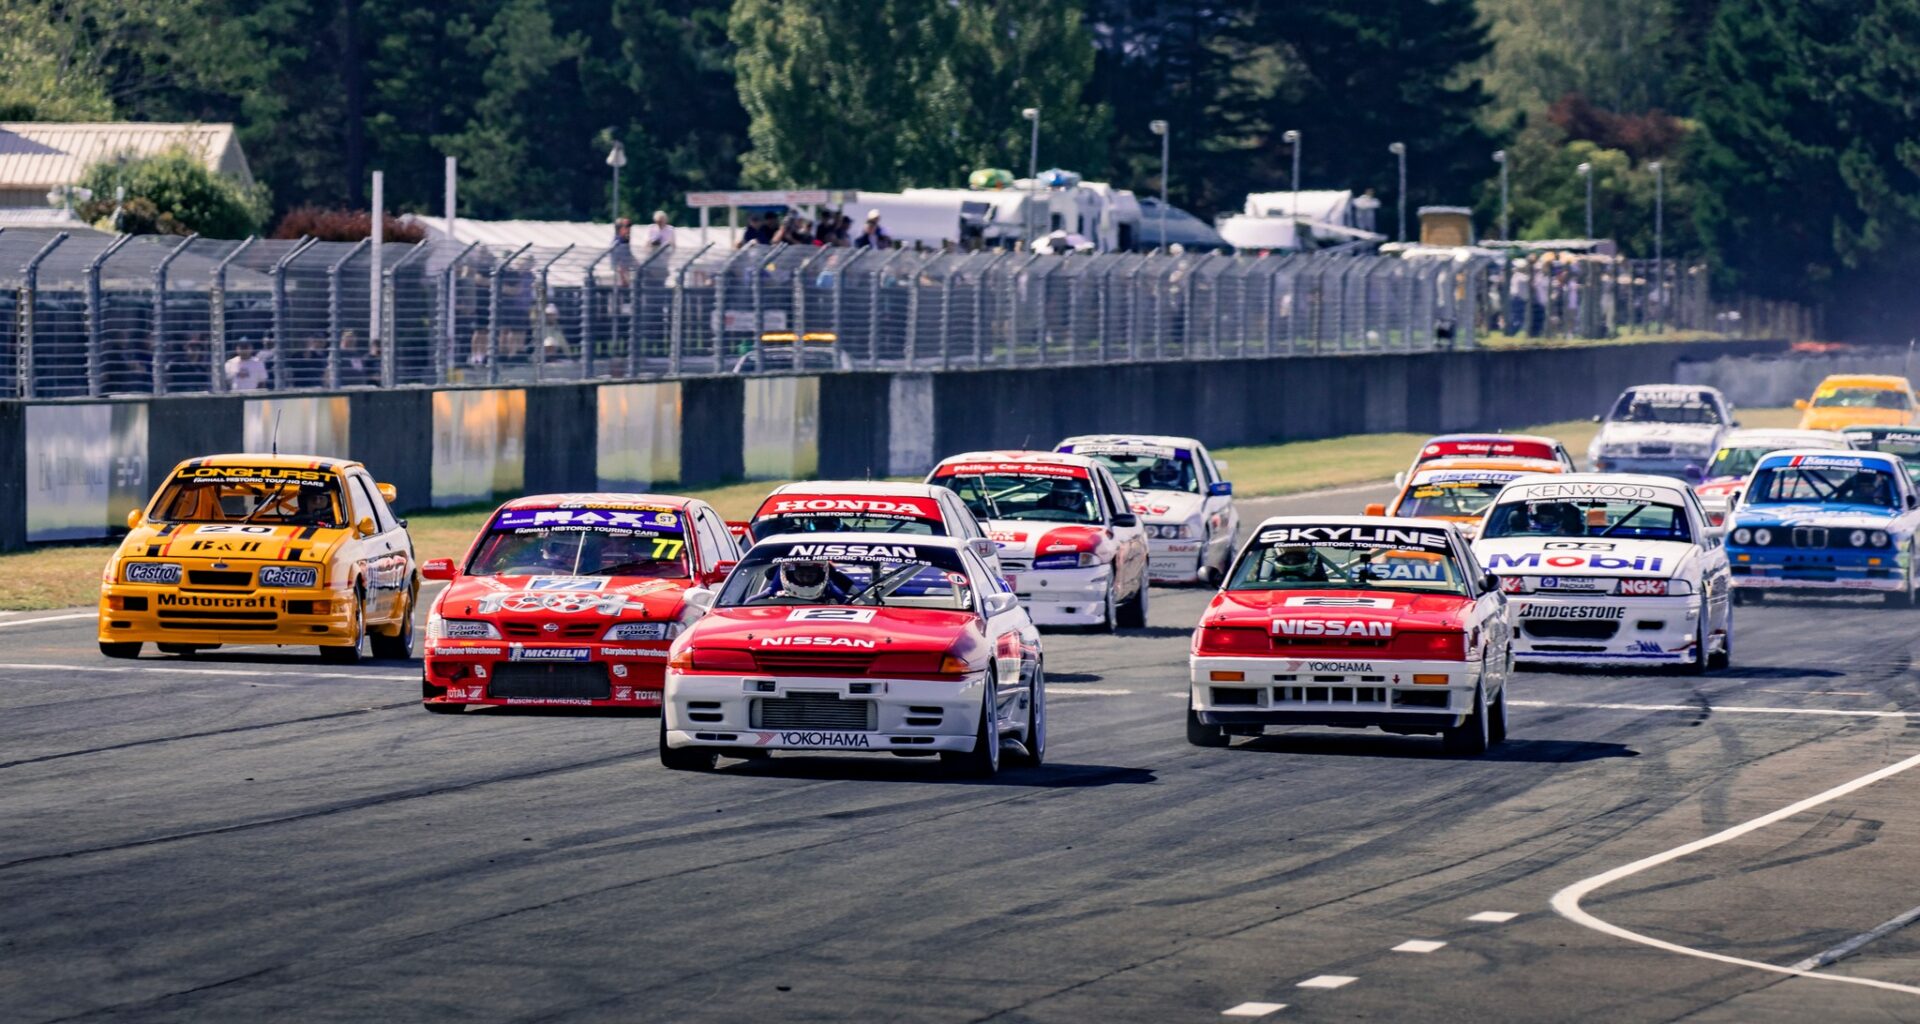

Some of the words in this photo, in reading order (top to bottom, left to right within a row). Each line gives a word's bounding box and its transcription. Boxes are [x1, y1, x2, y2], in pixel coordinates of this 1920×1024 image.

[177, 468, 338, 482] LONGHURST
[301, 480, 324, 488] CARS
[1526, 484, 1656, 498] KENWOOD
[774, 499, 926, 516] HONDA
[200, 525, 272, 534] 20
[551, 525, 592, 533] HISTORIC
[594, 526, 633, 534] TOURING
[633, 529, 660, 537] CARS
[1259, 527, 1446, 549] SKYLINE
[652, 538, 684, 560] 77
[788, 545, 917, 558] NISSAN
[1356, 542, 1397, 550] TOURING
[860, 556, 903, 564] TOURING
[1488, 553, 1663, 571] Mobil
[130, 565, 178, 580] Castrol
[263, 569, 313, 584] Castrol
[1621, 580, 1660, 594] NGK
[157, 593, 277, 608] Motorcraft
[804, 609, 858, 620] 2
[1518, 603, 1627, 619] BRIDGESTONE
[1271, 619, 1392, 637] NISSAN
[761, 637, 876, 648] NISSAN
[465, 646, 501, 655] Warehouse
[524, 649, 589, 658] MICHELIN
[1307, 661, 1373, 672] YOKOHAMA
[447, 689, 468, 698] OTAL
[780, 732, 870, 747] YOKOHAMA
